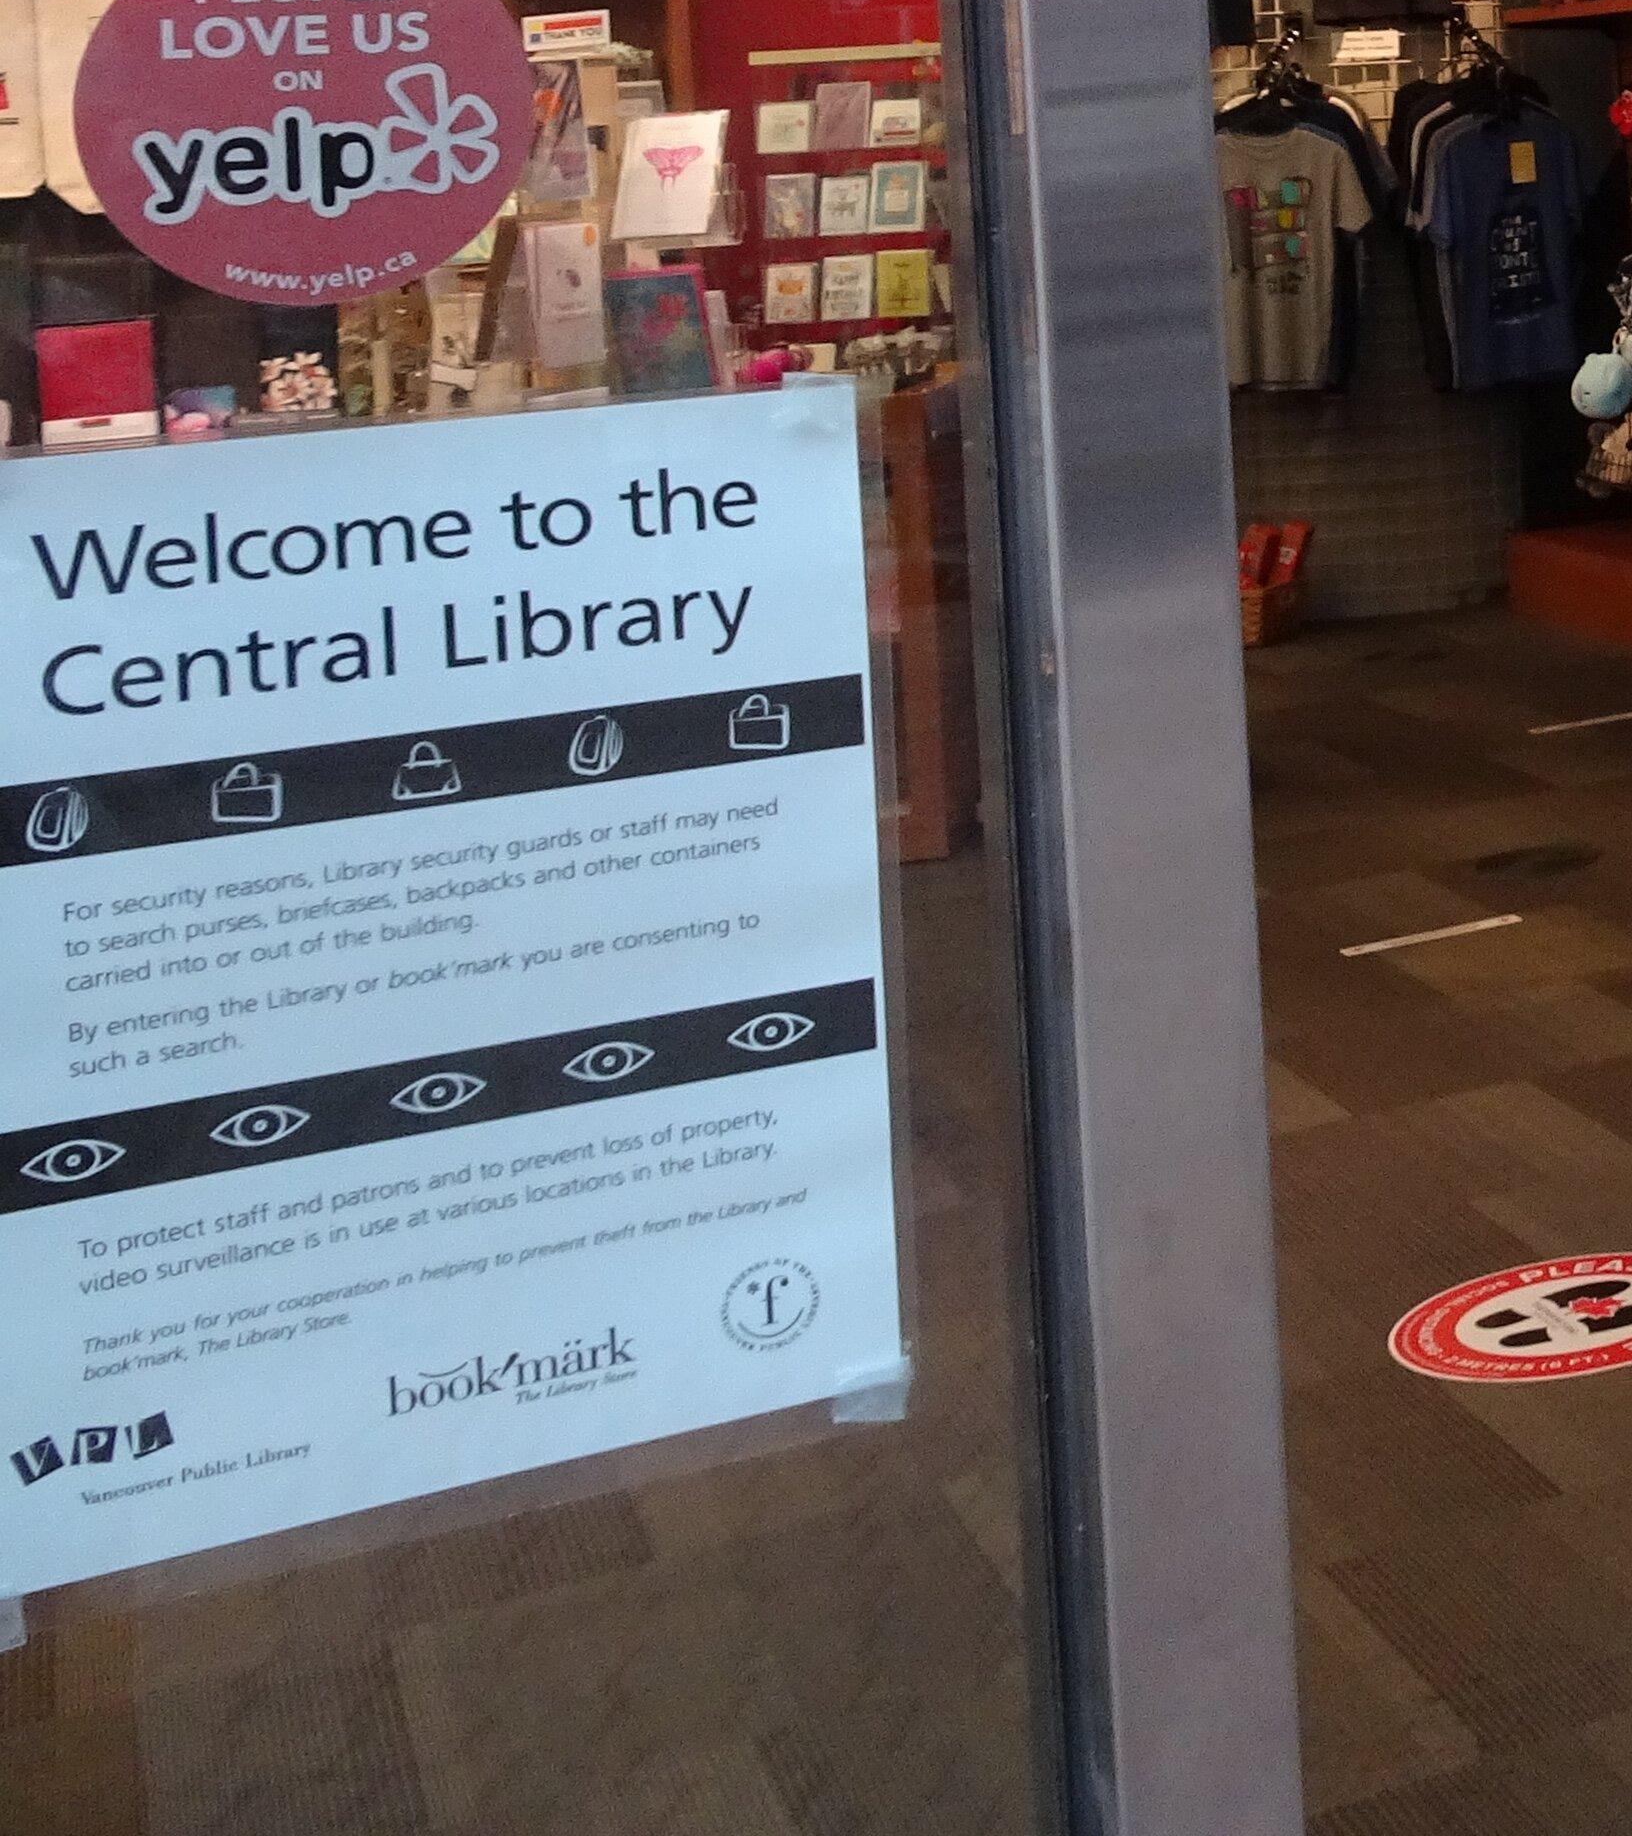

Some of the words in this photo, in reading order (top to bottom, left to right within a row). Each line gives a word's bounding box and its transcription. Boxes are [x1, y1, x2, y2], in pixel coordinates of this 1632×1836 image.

[162, 16, 331, 60] LOVE
[350, 12, 429, 53] US
[274, 69, 324, 92] ON
[143, 115, 376, 214] yelp
[223, 249, 419, 292] www.yelp.ca
[33, 510, 472, 600] Welcome
[503, 491, 590, 551] to
[621, 468, 758, 538] the
[43, 606, 396, 715] Central
[444, 586, 752, 668] Library
[63, 901, 103, 922] For
[111, 888, 207, 916] security
[323, 859, 403, 884] Library
[410, 844, 499, 871] security
[506, 828, 583, 861] guards
[589, 826, 613, 843] or
[619, 812, 668, 839] staff
[675, 812, 719, 830] may
[727, 797, 778, 822] need
[64, 940, 90, 957] to
[98, 923, 176, 953] search
[406, 871, 526, 904] backpacks
[533, 860, 576, 885] and
[583, 854, 642, 877] other
[650, 836, 761, 866] containers
[65, 959, 151, 992] carried
[161, 956, 208, 976] into
[216, 950, 241, 968] or
[250, 941, 291, 962] out
[299, 931, 325, 955] of
[333, 929, 372, 950] the
[68, 1022, 98, 1045] By
[106, 1006, 210, 1036] entering
[218, 997, 258, 1017] the
[267, 983, 347, 1010] Library
[354, 977, 379, 995] or
[521, 947, 562, 972] you
[570, 940, 605, 959] are
[612, 919, 730, 951] consenting
[738, 914, 760, 930] to
[69, 1051, 126, 1078] such
[135, 1050, 150, 1066] a
[77, 1238, 108, 1259] To
[117, 1218, 205, 1257] protect
[214, 1202, 270, 1233] staff
[278, 1193, 323, 1221] and
[331, 1179, 420, 1214] patrons
[427, 1164, 472, 1190] and
[479, 1162, 504, 1181] to
[511, 1142, 595, 1177] prevent
[603, 1135, 644, 1155] loss
[650, 1123, 673, 1146] of
[79, 1268, 148, 1295] video
[156, 1238, 295, 1280] surveillance
[304, 1232, 321, 1249] is
[329, 1226, 350, 1243] in
[359, 1217, 399, 1238] use
[407, 1208, 430, 1228] at
[436, 1192, 518, 1221] various
[526, 1171, 625, 1203] locations
[632, 1166, 652, 1181] in
[659, 1157, 695, 1177] the
[518, 1235, 586, 1265] prevent
[593, 1224, 636, 1245] theft
[642, 1217, 682, 1234] from
[717, 1199, 772, 1220] Library
[236, 1324, 298, 1348] Library
[9, 1410, 175, 1487] VPL
[81, 1476, 174, 1505] Vancouver
[181, 1460, 238, 1483] Public
[246, 1445, 309, 1468] Library
